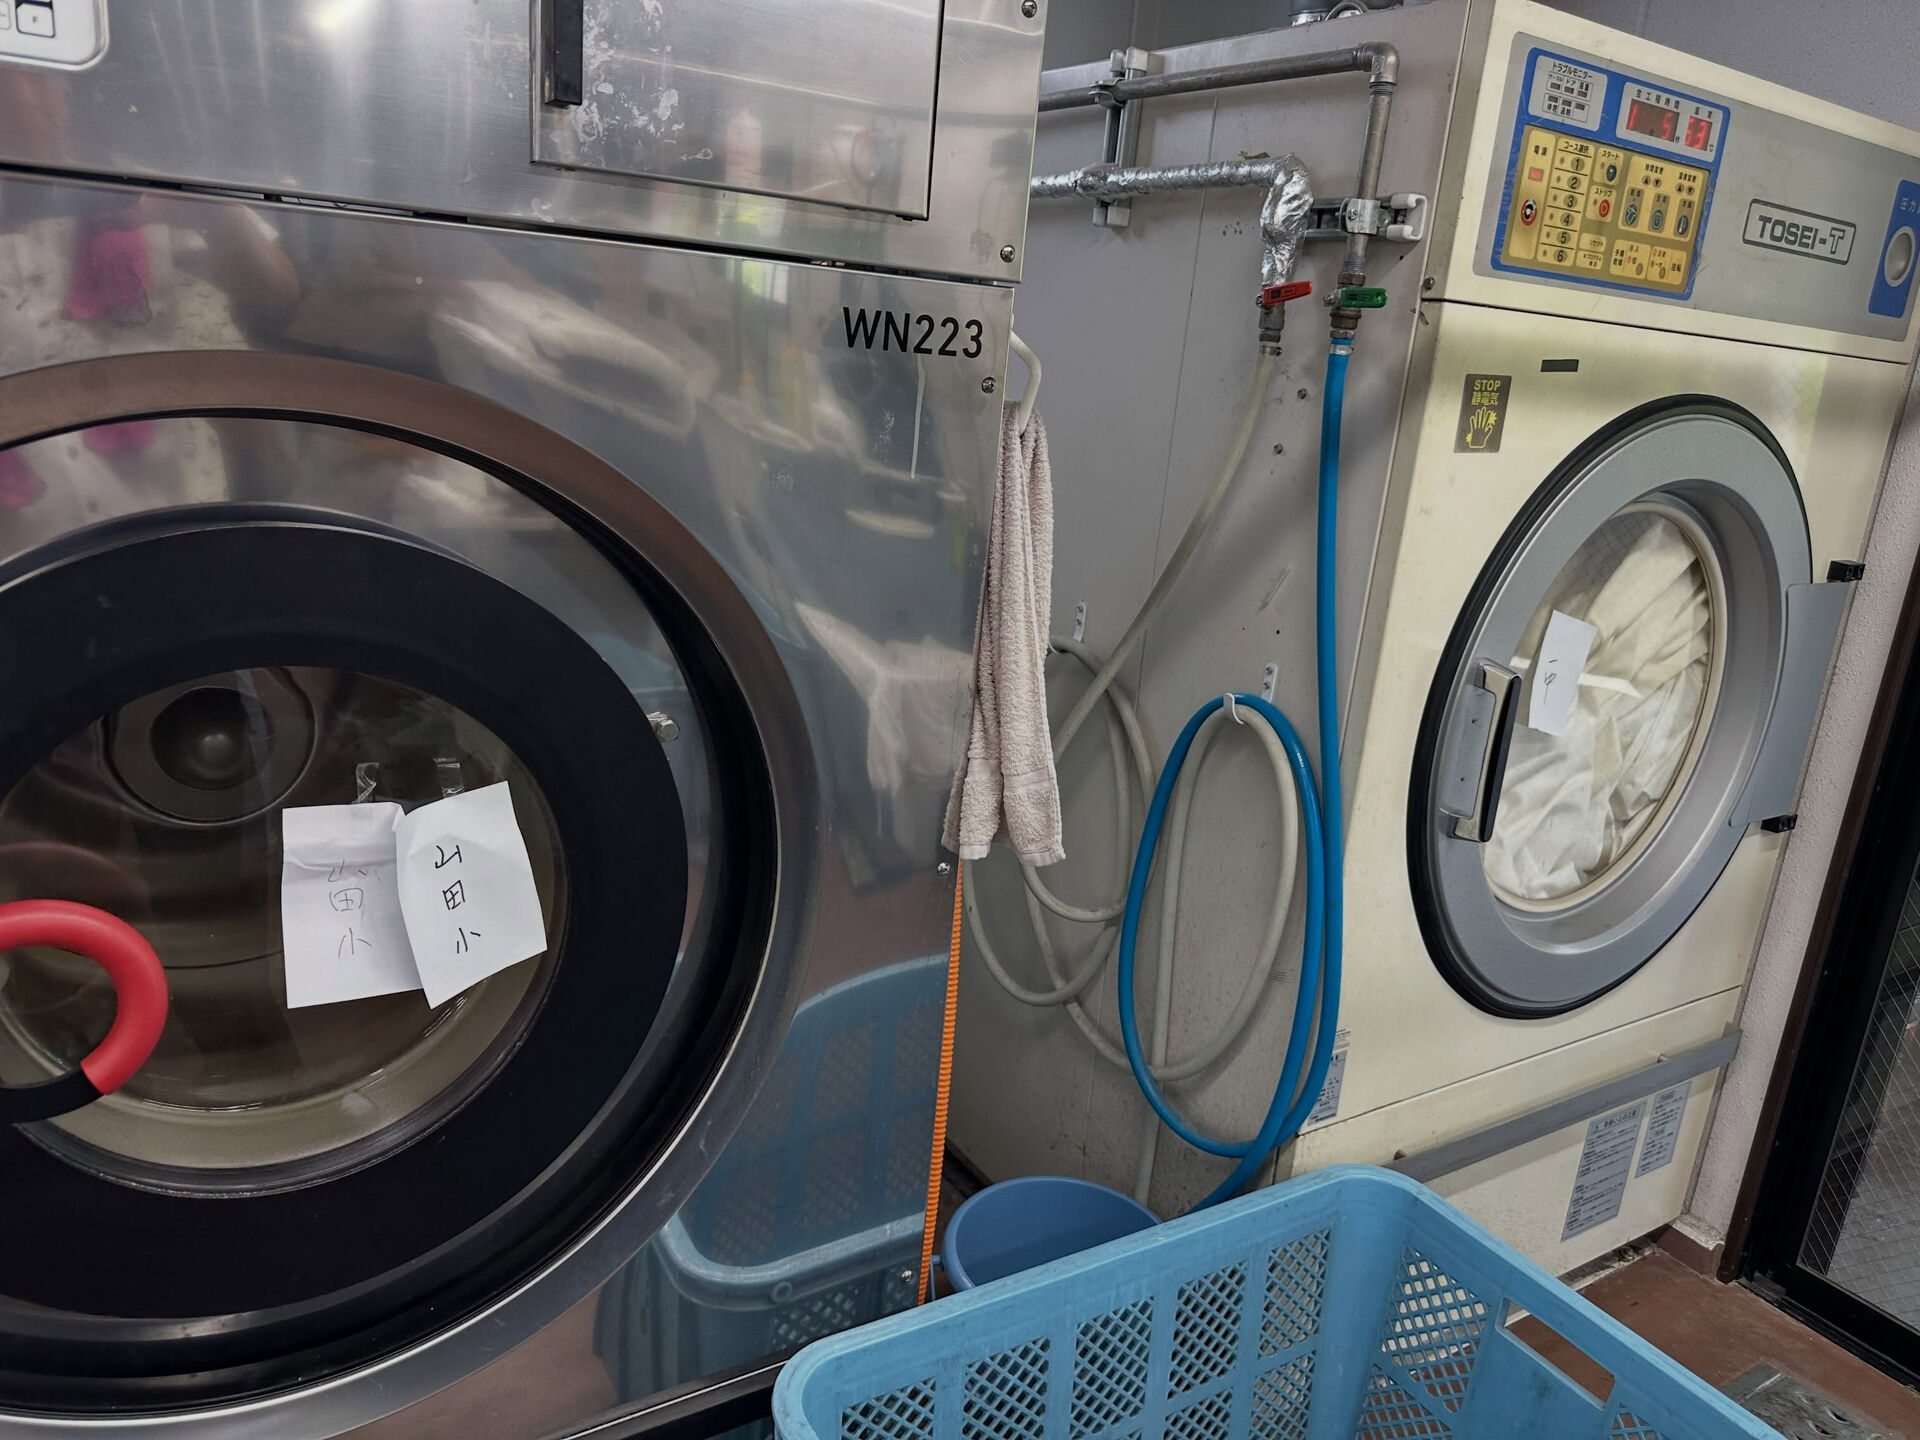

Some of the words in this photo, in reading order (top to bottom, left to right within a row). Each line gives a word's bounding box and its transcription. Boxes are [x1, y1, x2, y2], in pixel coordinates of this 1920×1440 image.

[1552, 61, 1593, 80] トラブルモニター
[1601, 150, 1621, 160] スタート
[1574, 158, 1580, 172] 1
[1570, 177, 1578, 190] 2
[1594, 187, 1613, 197] ストップ
[1566, 195, 1574, 208] 3
[1563, 214, 1571, 226] 4
[1560, 233, 1568, 244] 5
[1556, 250, 1564, 262] 6
[843, 306, 984, 359] WN223
[1473, 379, 1501, 392] STOP
[1471, 391, 1500, 406] 静電気
[434, 844, 482, 954] 山田小
